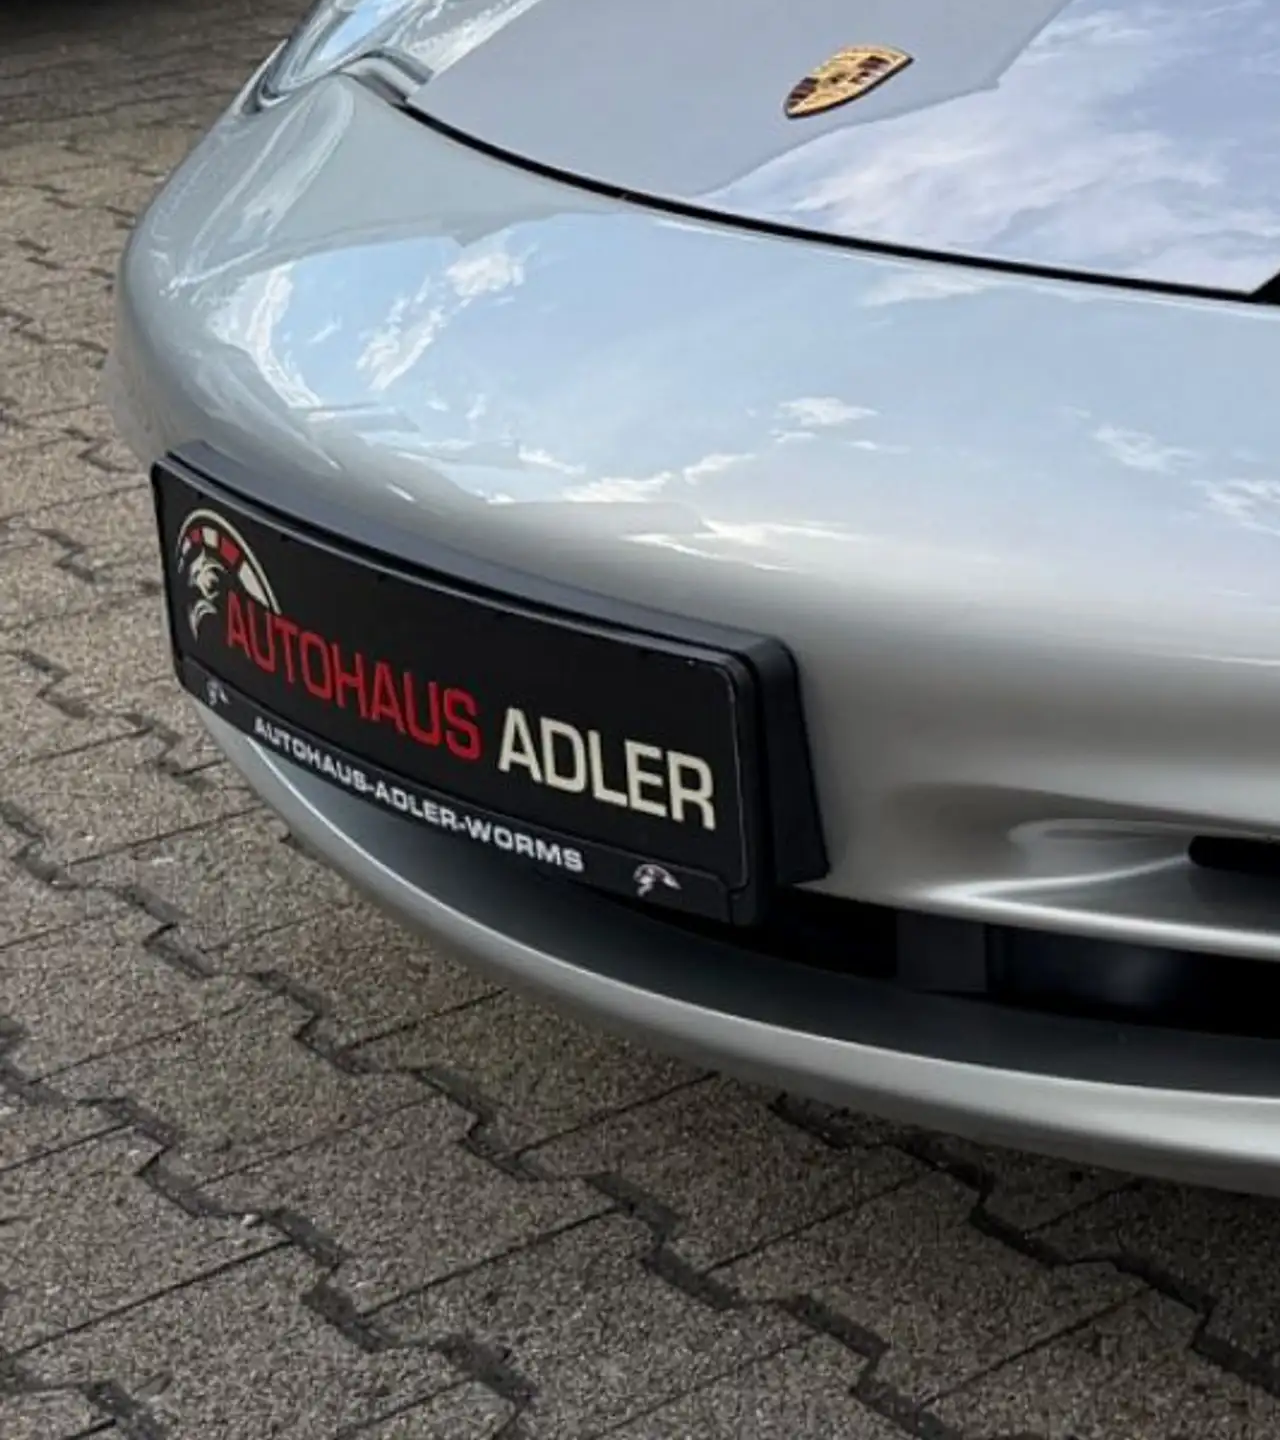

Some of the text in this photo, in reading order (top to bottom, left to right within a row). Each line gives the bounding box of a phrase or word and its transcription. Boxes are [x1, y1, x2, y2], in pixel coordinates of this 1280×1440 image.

[226, 591, 716, 831] AUTOHAUS ADLER
[252, 716, 585, 875] AUTOHAUS-ADLER-WORMS
